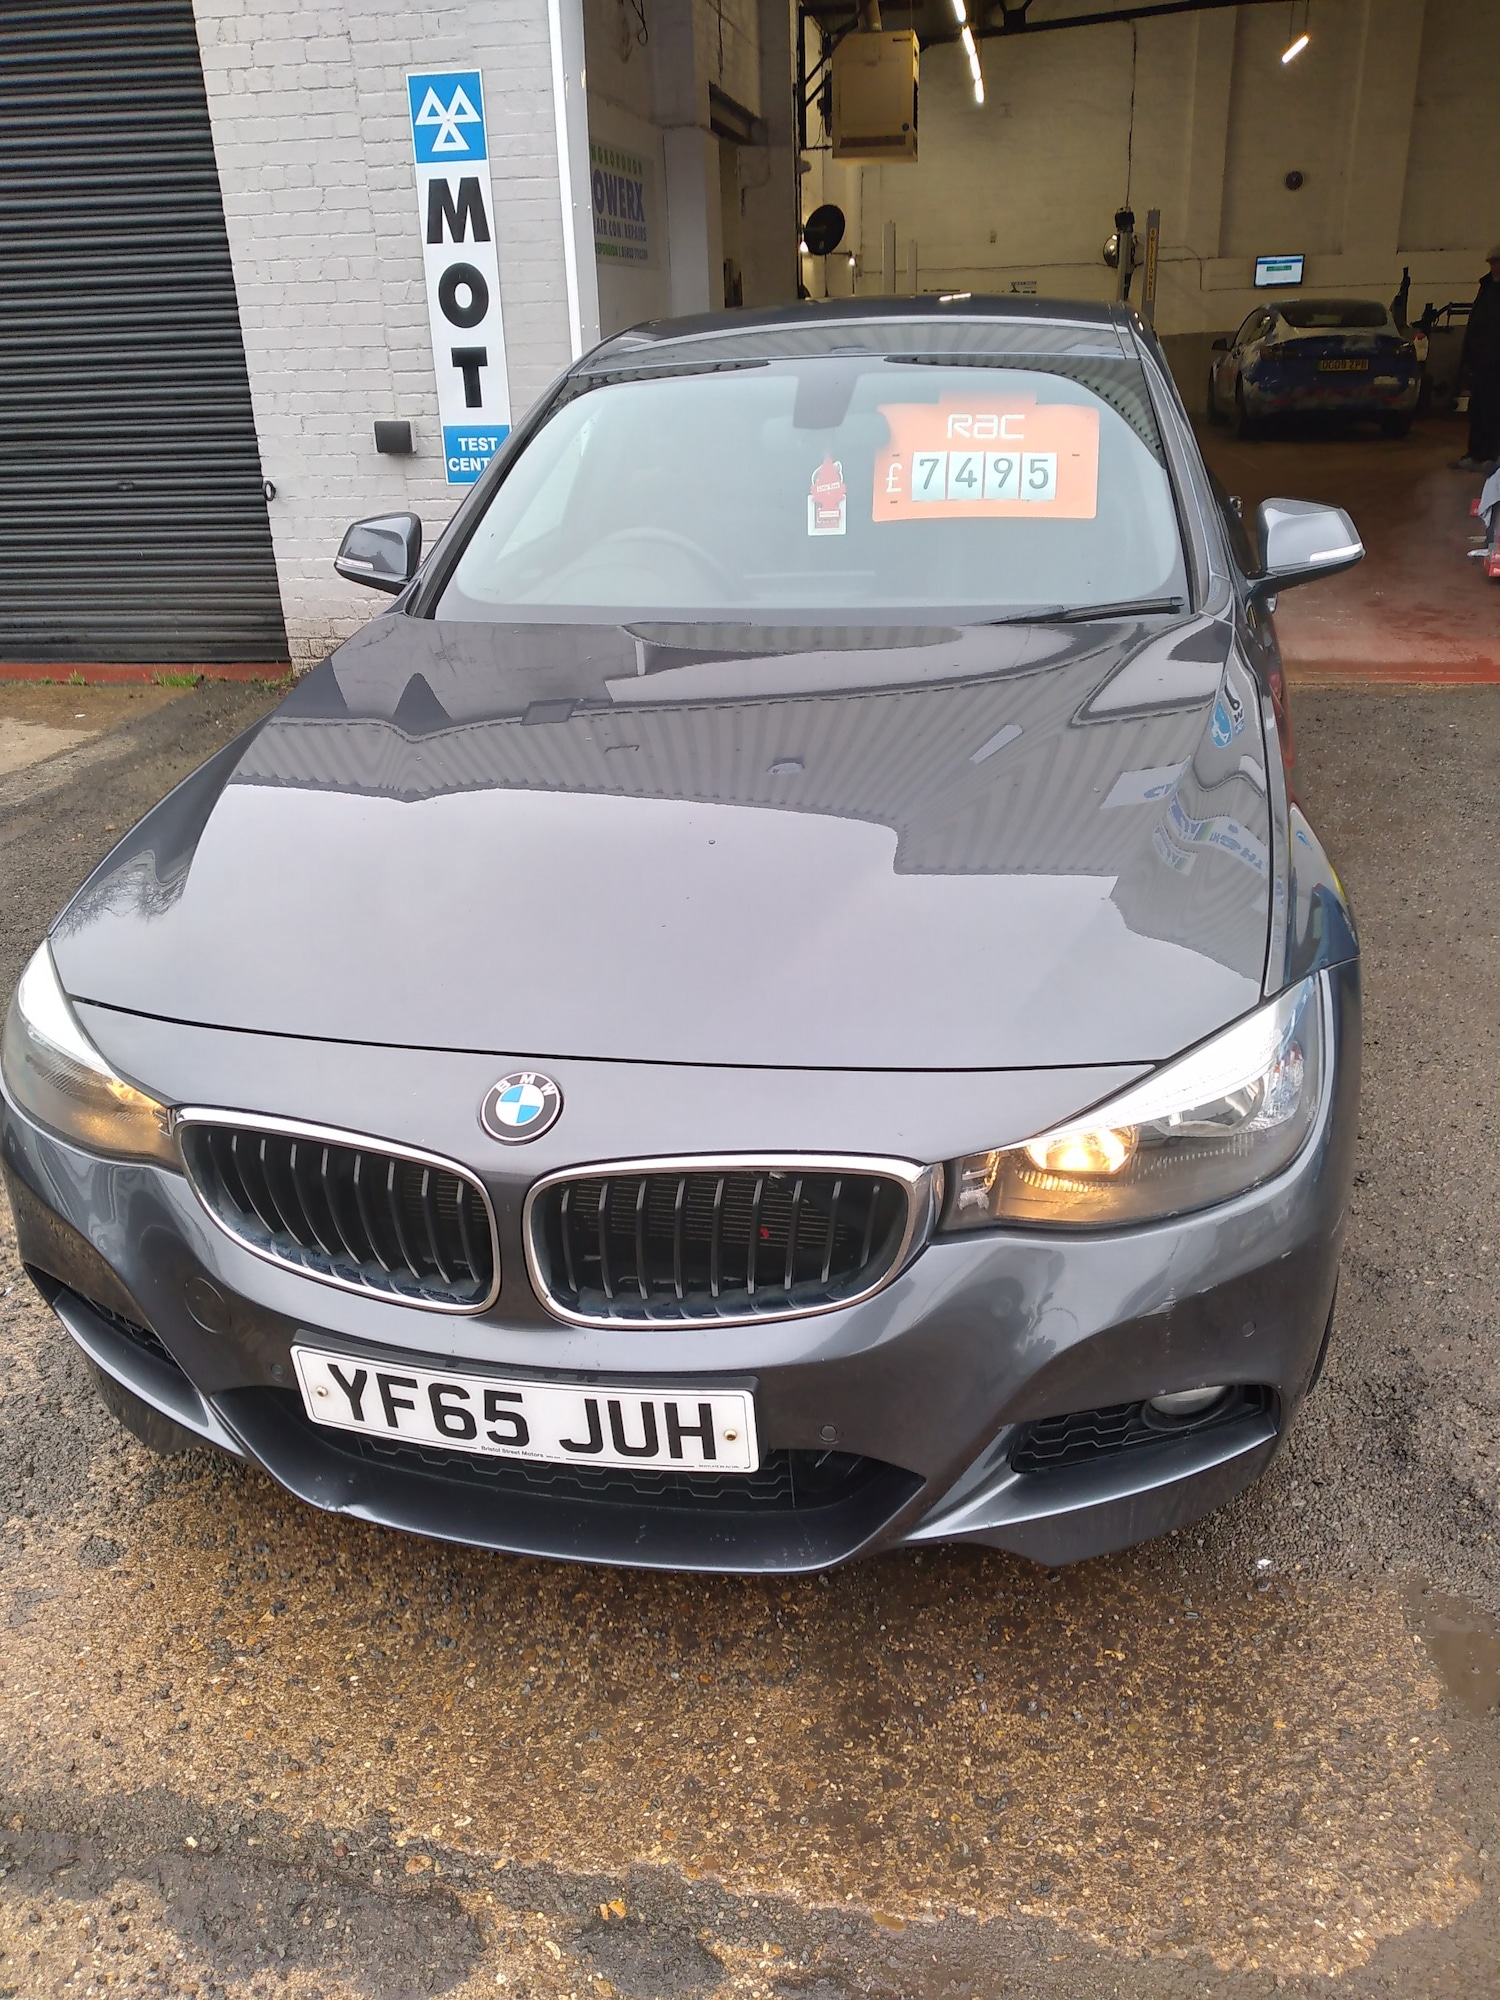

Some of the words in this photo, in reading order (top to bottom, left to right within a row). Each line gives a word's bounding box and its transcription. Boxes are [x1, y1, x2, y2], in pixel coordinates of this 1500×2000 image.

[427, 176, 491, 408] MOT
[458, 437, 498, 452] TEST
[496, 1074, 556, 1096] BMW
[327, 1363, 530, 1448] YF65
[559, 1398, 717, 1461] JUH
